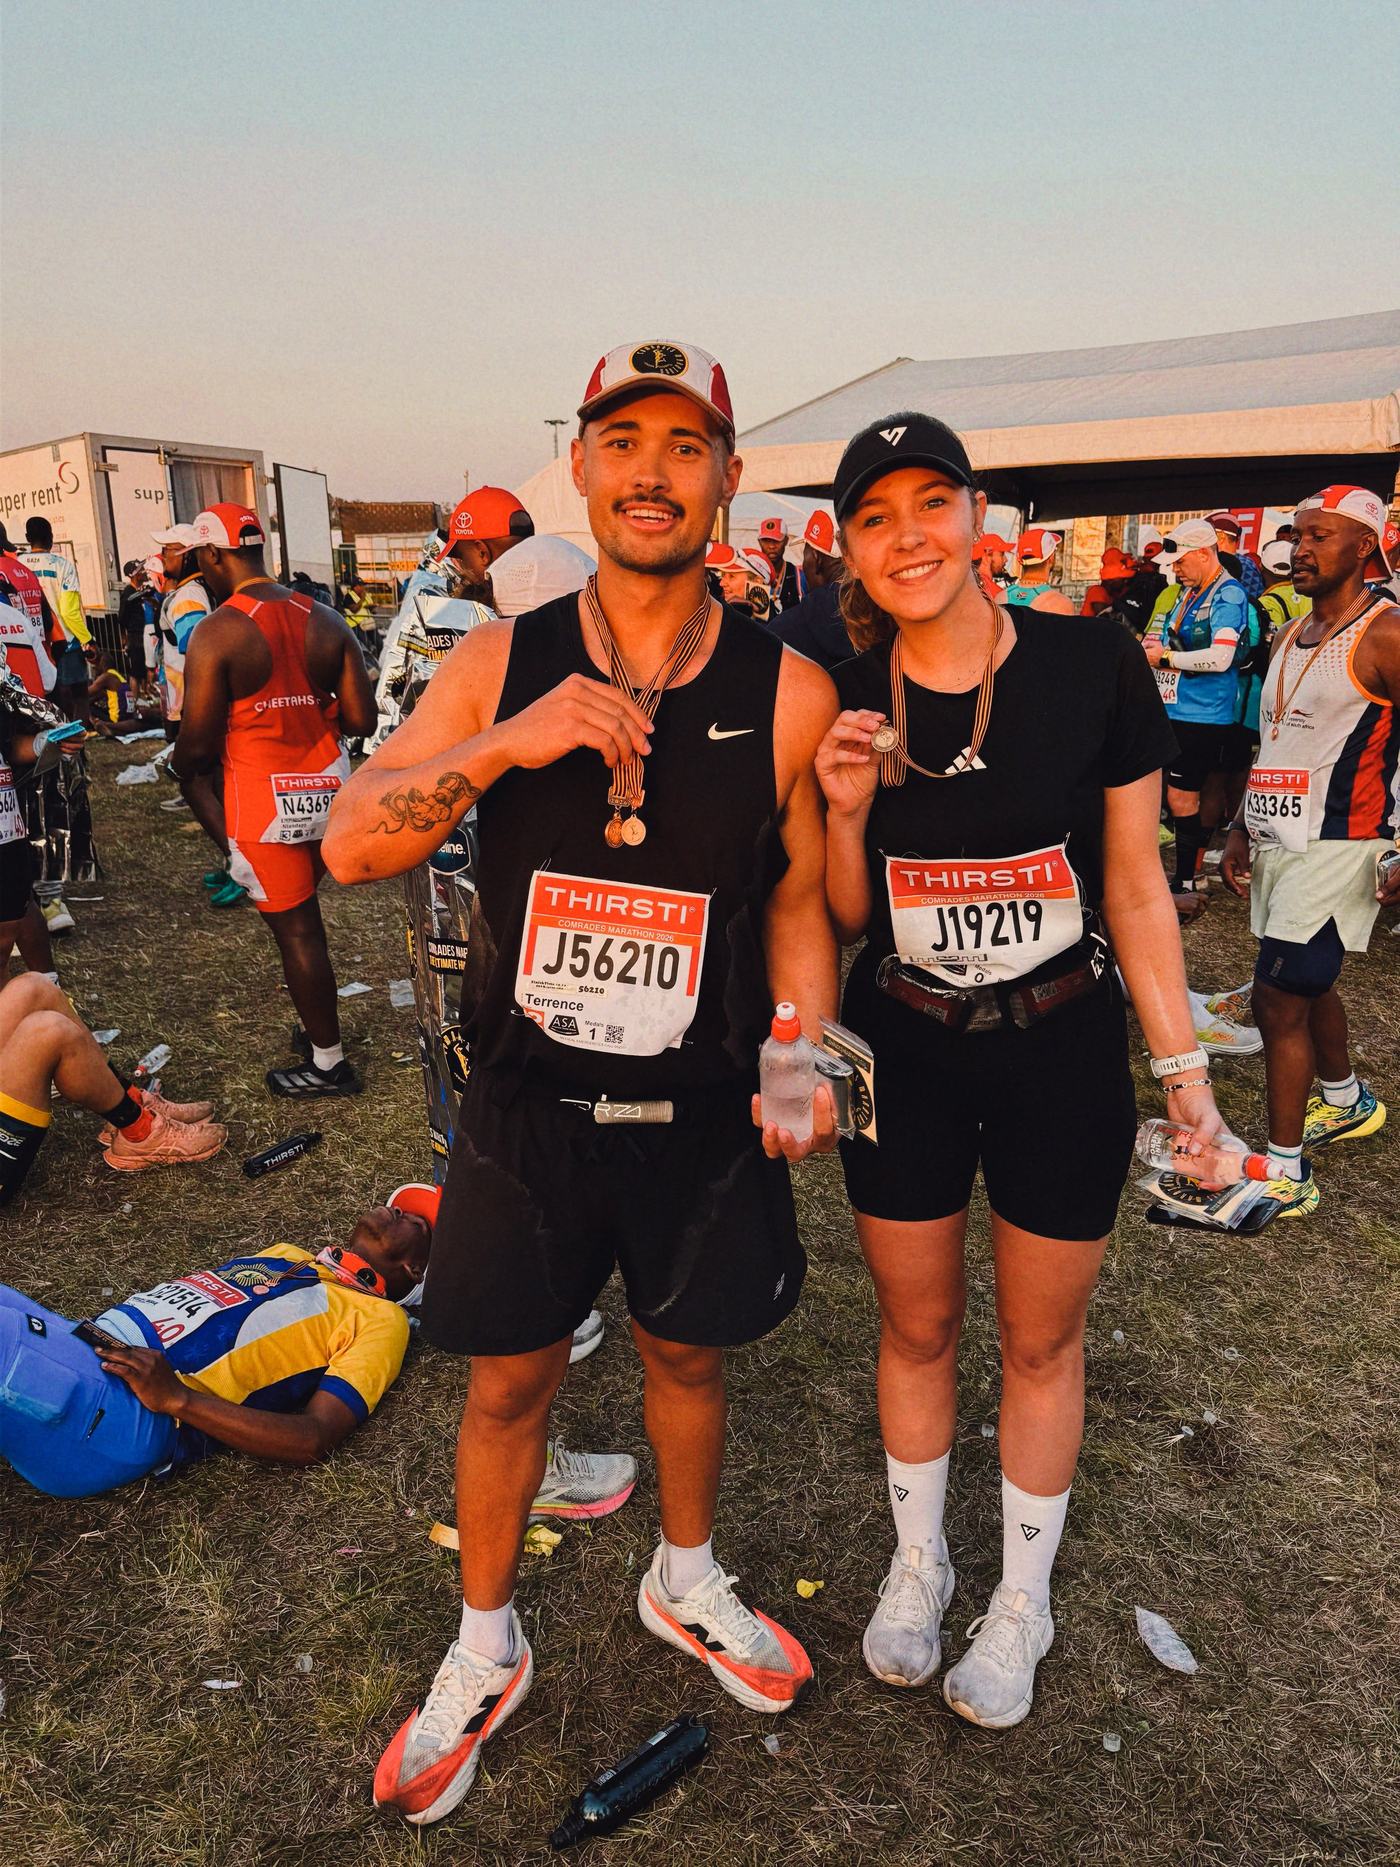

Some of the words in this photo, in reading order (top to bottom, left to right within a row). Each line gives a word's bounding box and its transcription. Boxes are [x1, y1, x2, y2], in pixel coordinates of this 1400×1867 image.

[32, 482, 62, 507] rent
[10, 625, 24, 633] AC
[254, 694, 315, 713] CHEETAHS
[278, 777, 336, 789] THIRSTI
[1247, 789, 1302, 818] K33365
[900, 861, 1053, 889] THIRSTI
[545, 886, 688, 925] THIRSTI
[920, 895, 970, 905] COMRADES
[972, 891, 1023, 902] MARATHON
[558, 919, 606, 932] COMRADES
[608, 925, 654, 939] MARATHON
[656, 933, 675, 943] 2026
[931, 899, 1043, 952] J19219
[542, 931, 680, 990] J56210
[578, 985, 605, 995] 56210
[525, 993, 584, 1012] Terrence
[553, 1016, 577, 1029] ASA
[589, 1028, 597, 1041] 1
[264, 1143, 304, 1167] THIRSTI
[152, 1317, 185, 1343] 40
